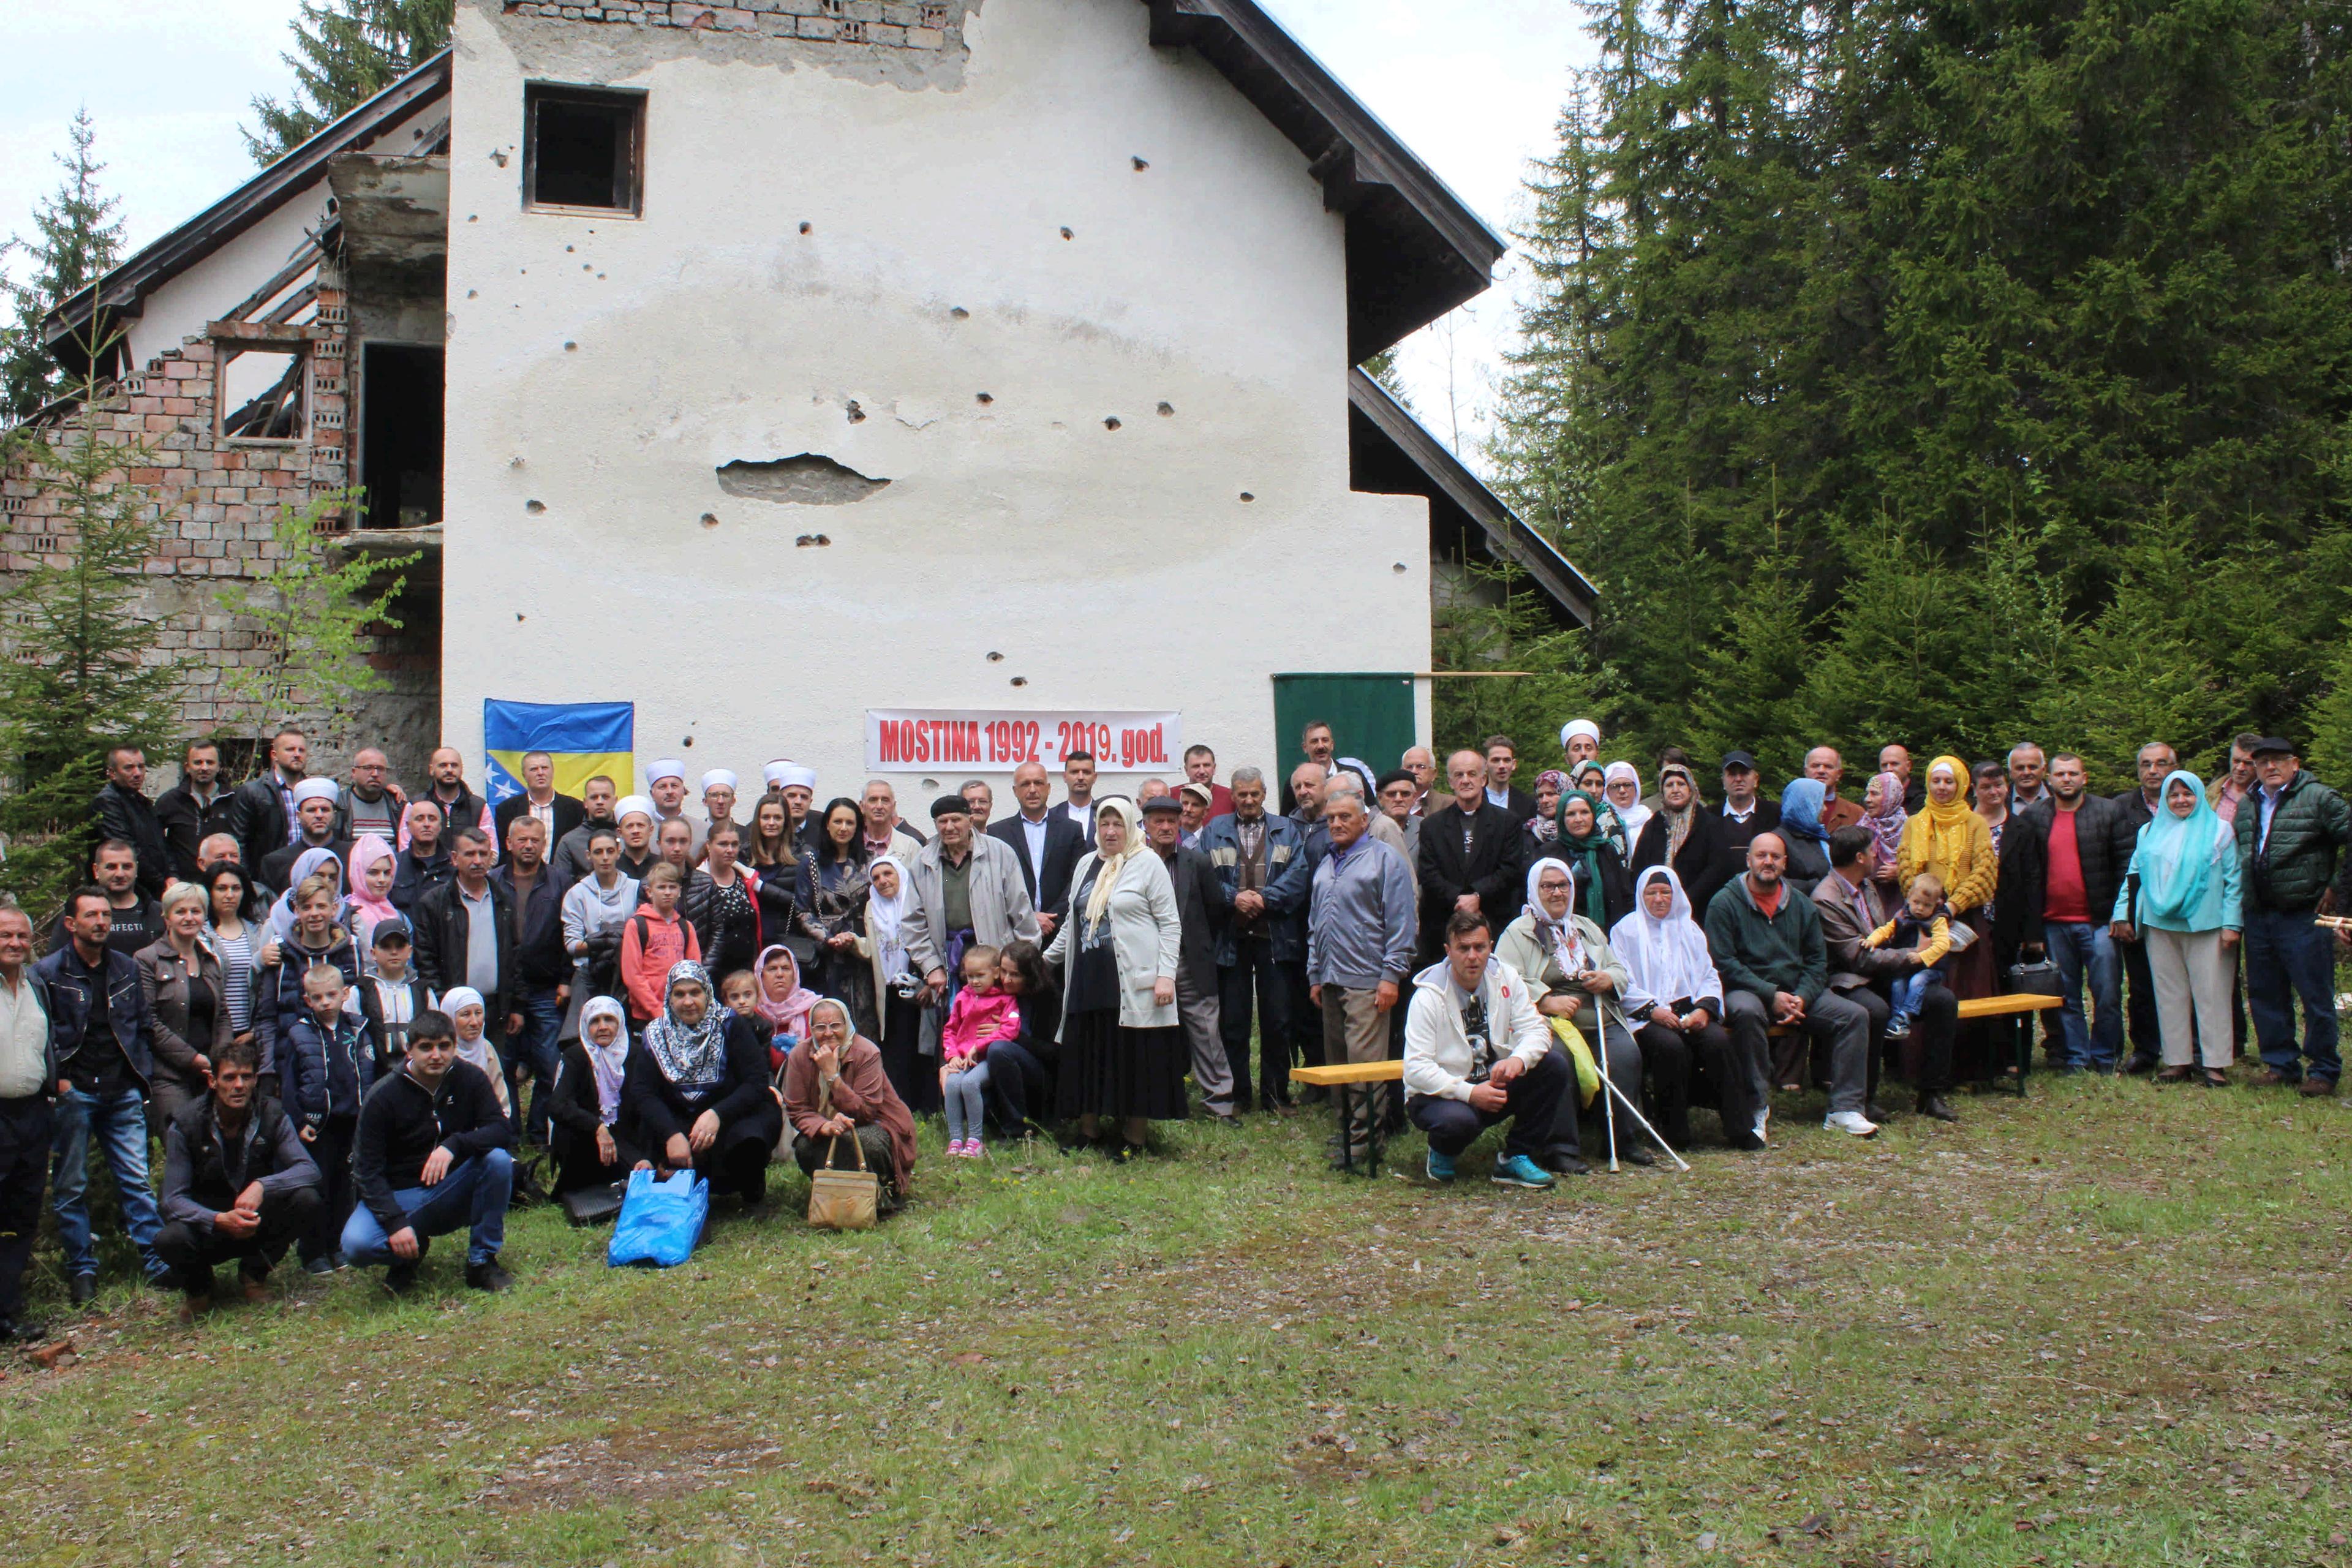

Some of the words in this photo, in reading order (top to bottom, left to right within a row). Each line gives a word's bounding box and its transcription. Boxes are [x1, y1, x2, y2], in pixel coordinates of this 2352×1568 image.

[880, 720, 981, 763] MOSTINA
[985, 720, 1039, 763] 1992
[1058, 721, 1117, 763] 2019.
[1121, 722, 1168, 767] god.
